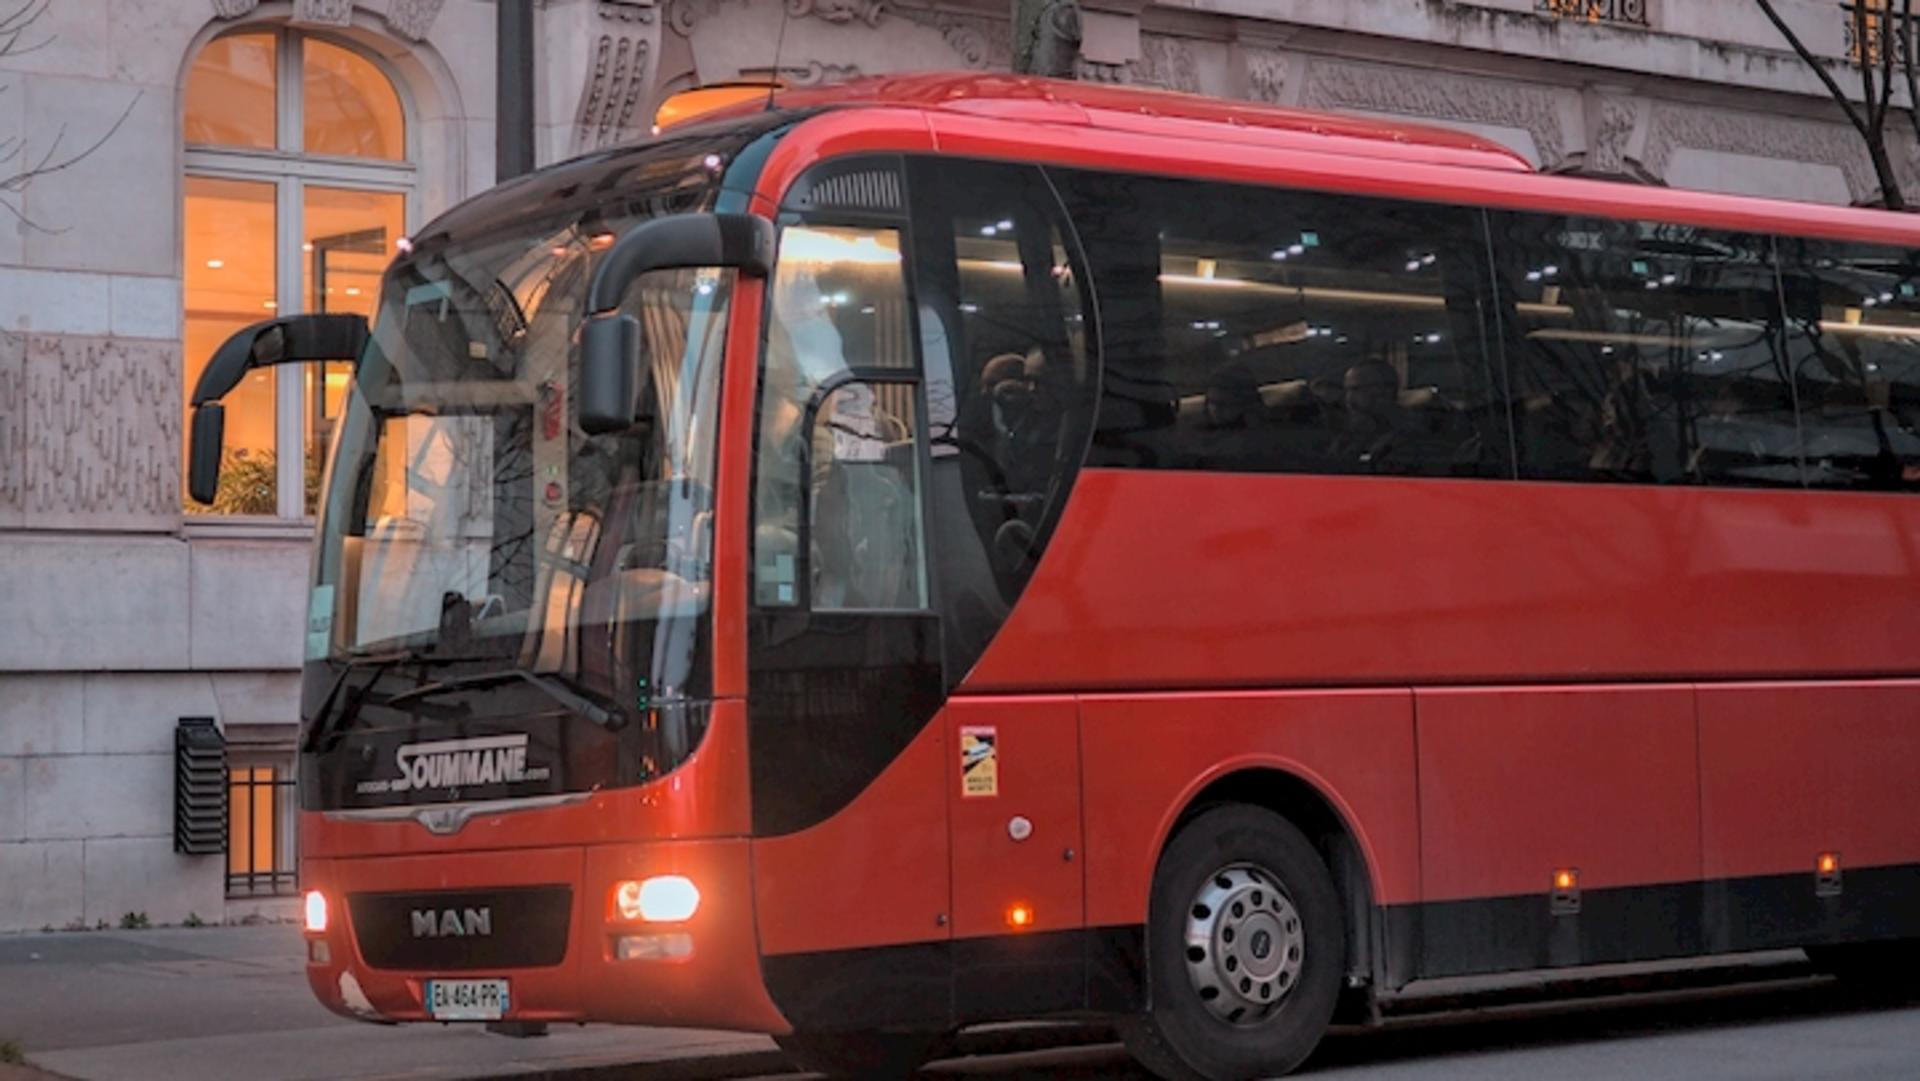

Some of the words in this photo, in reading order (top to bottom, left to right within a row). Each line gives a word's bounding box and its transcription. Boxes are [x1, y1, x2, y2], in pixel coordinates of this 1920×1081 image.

[392, 734, 529, 792] SOUMMANE
[411, 906, 492, 937] MAN
[434, 983, 501, 1008] EA-464-PR
